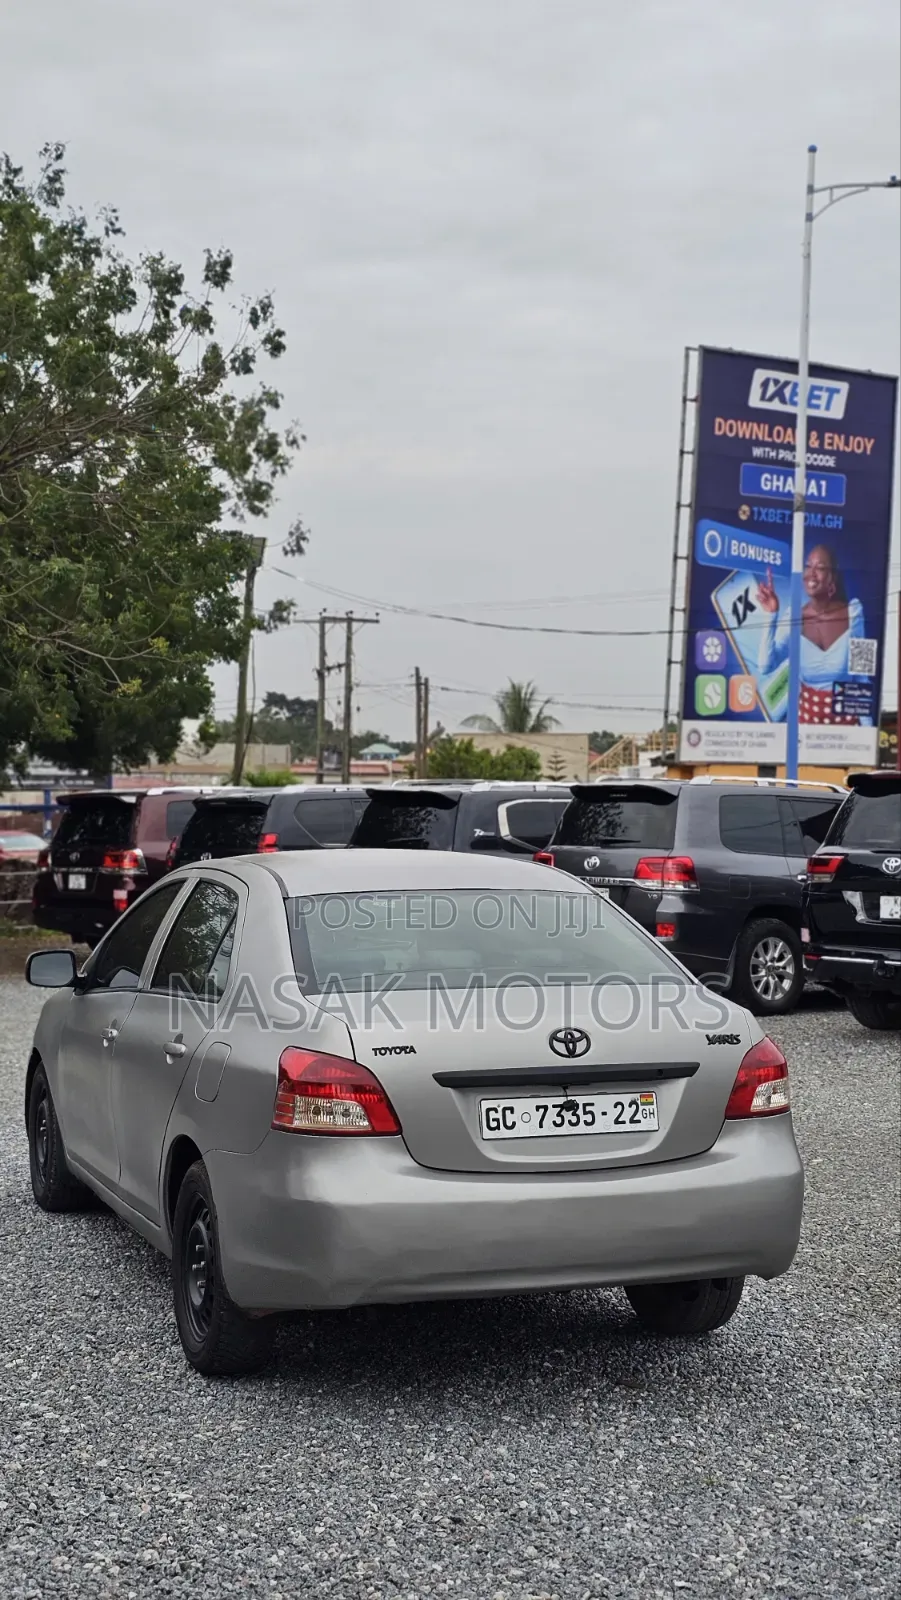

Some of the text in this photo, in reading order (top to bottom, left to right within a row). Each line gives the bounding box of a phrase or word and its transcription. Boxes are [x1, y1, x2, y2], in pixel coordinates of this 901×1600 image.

[714, 416, 875, 455] DOWNLOA & ENJOY
[752, 446, 837, 467] WITH PROOCODE
[752, 506, 843, 529] 1XBET.OM.GH
[731, 539, 782, 566] BONUSES
[371, 1045, 417, 1056] TOYOTA
[485, 1106, 517, 1131] GC
[641, 1108, 656, 1119] GH
